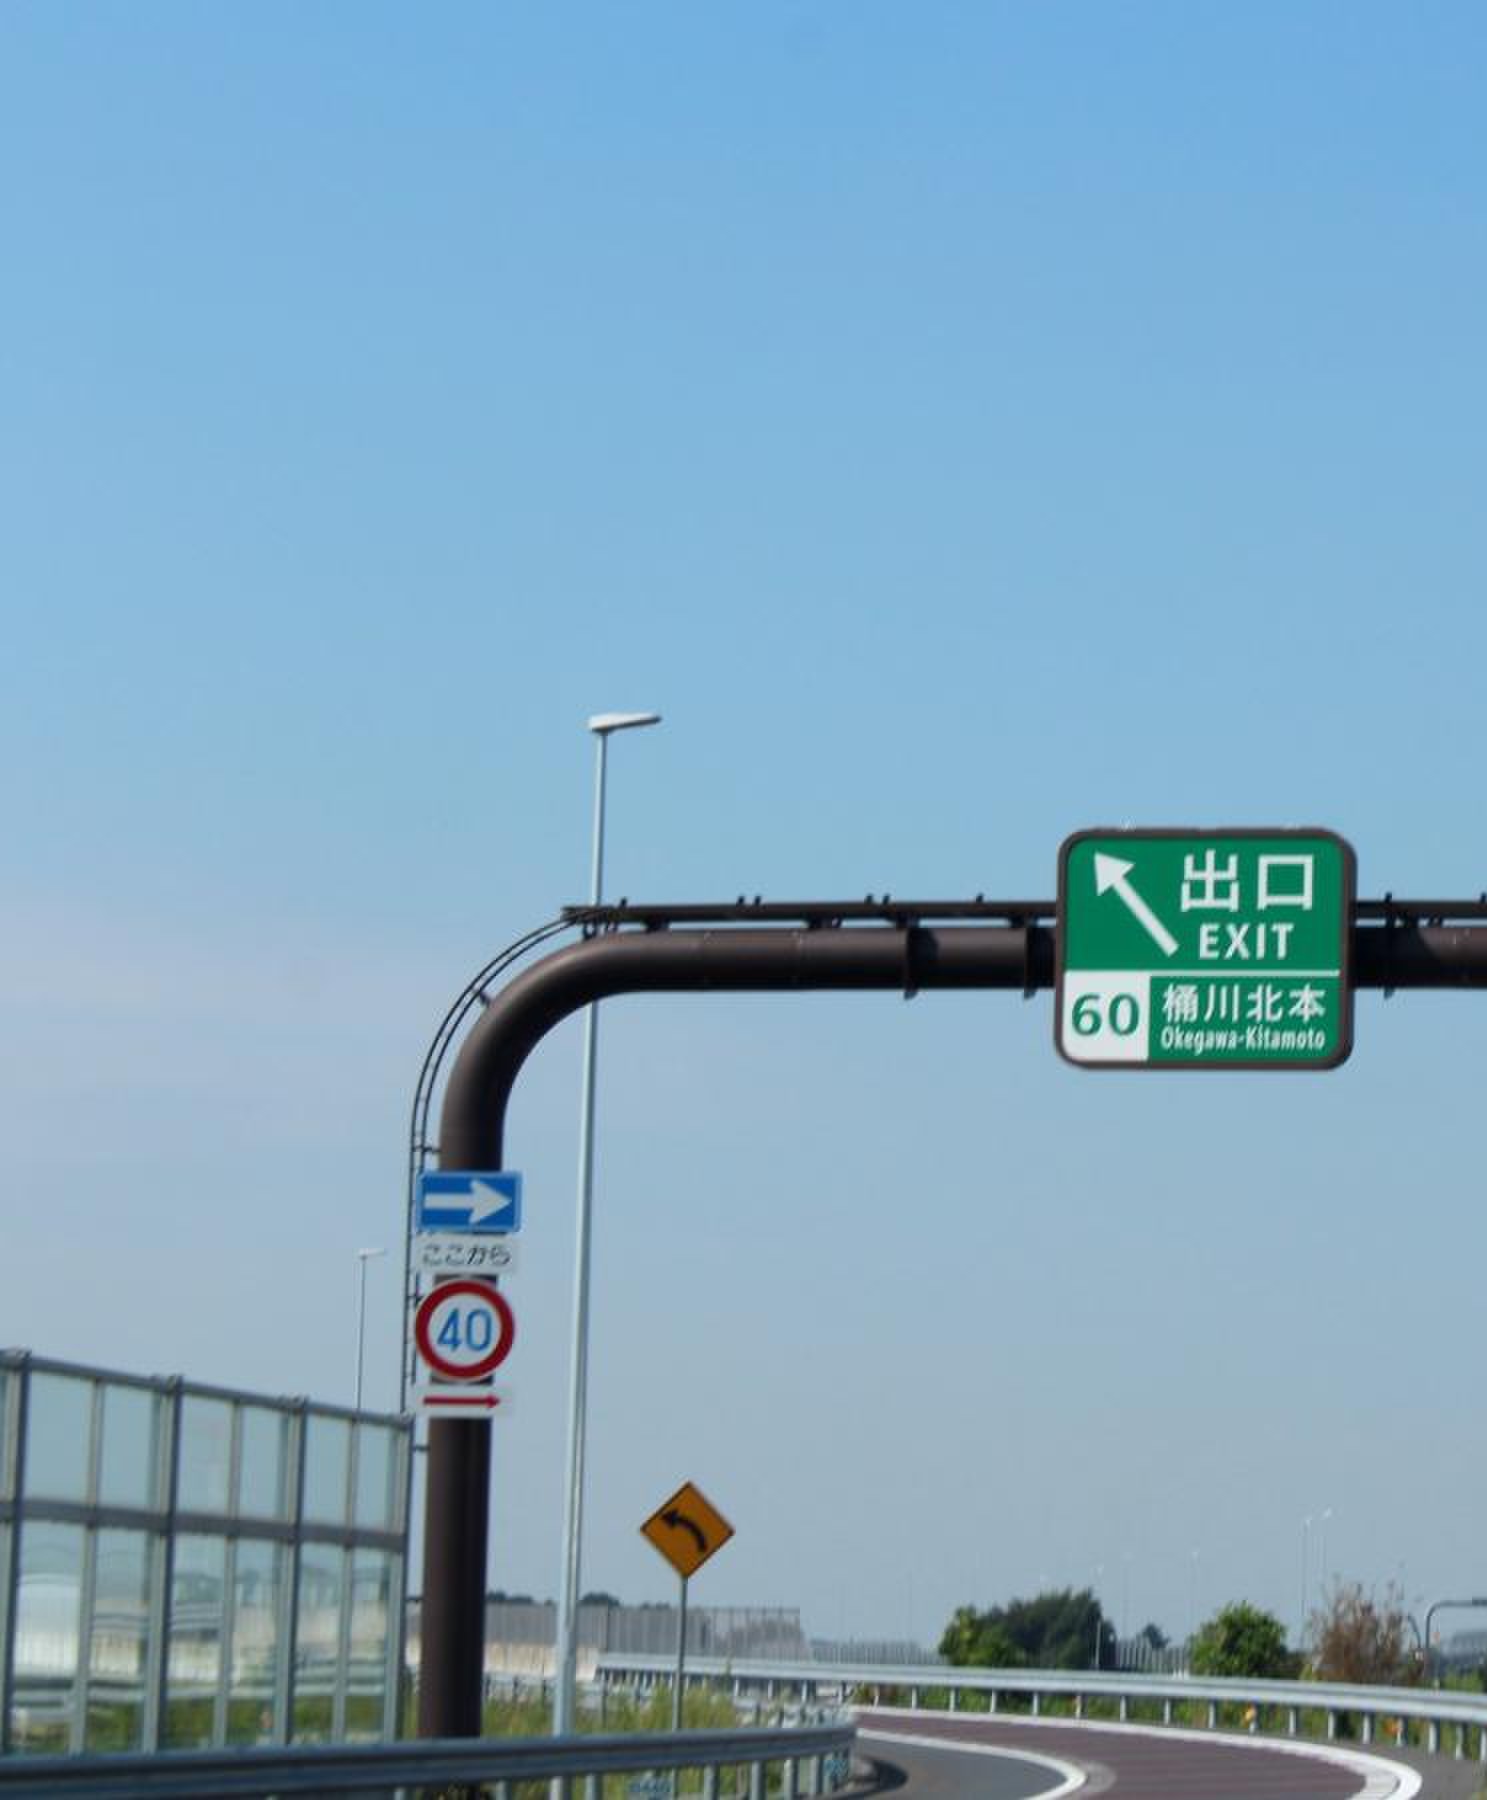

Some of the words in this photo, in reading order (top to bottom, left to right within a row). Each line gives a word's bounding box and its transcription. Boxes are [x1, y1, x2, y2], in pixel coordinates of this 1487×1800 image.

[1180, 849, 1314, 913] 出口
[1199, 922, 1295, 960] EXIT
[1072, 993, 1140, 1036] 60
[1162, 983, 1327, 1024] 桶川北本
[1160, 1024, 1326, 1055] Okegawa-Kitamoto
[423, 1243, 513, 1266] ここから
[437, 1307, 493, 1352] 40
